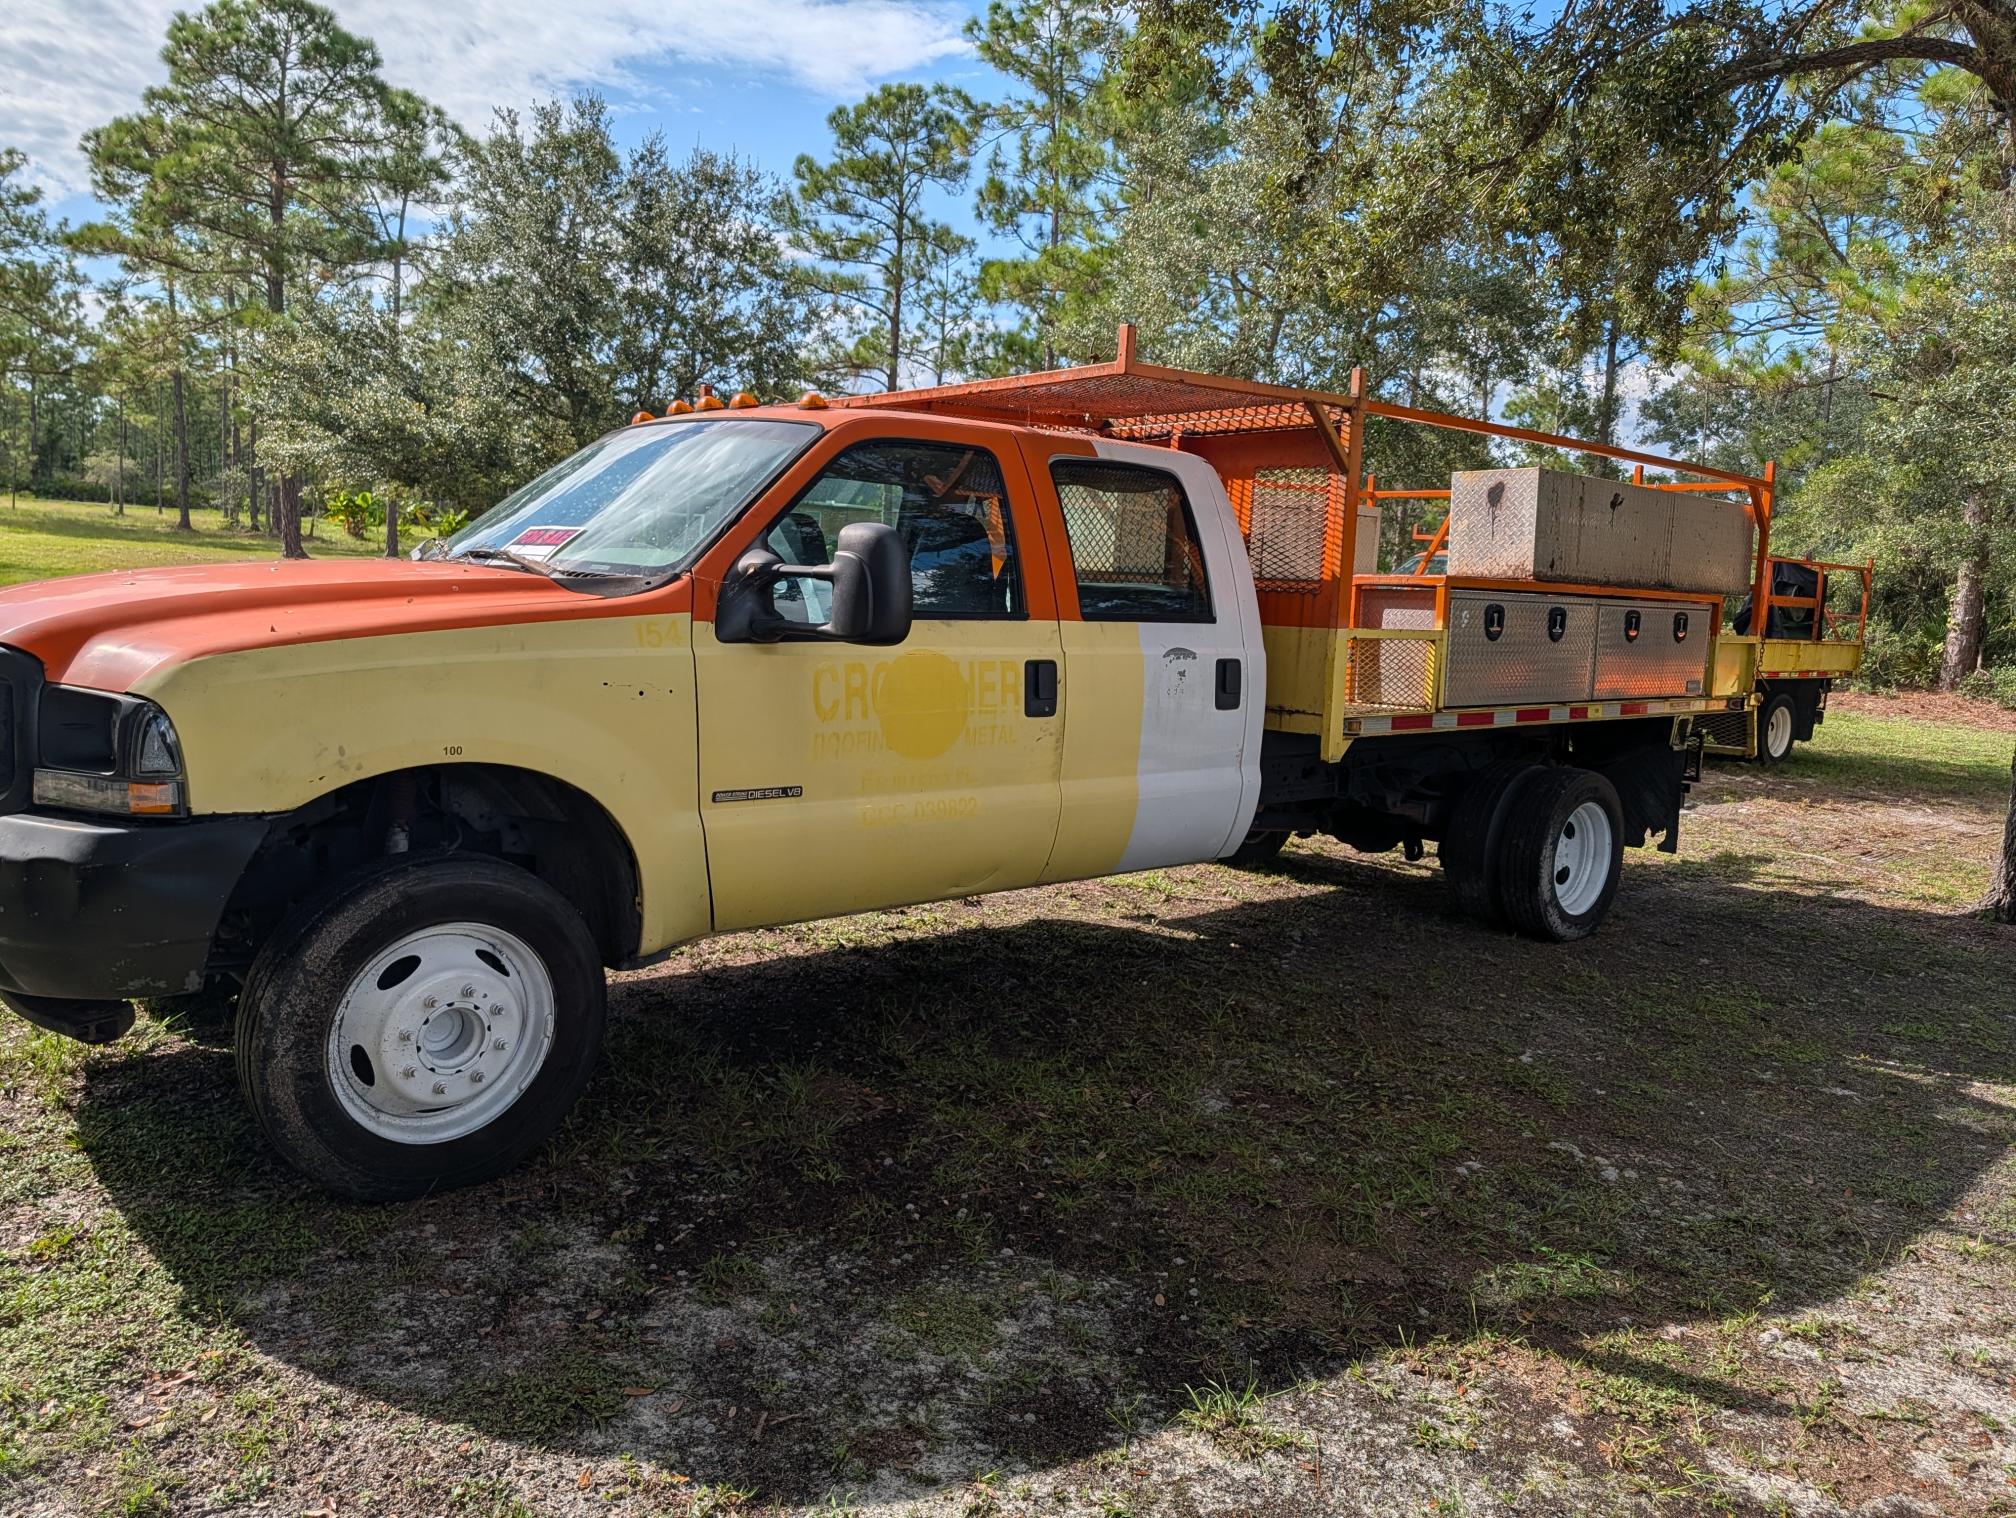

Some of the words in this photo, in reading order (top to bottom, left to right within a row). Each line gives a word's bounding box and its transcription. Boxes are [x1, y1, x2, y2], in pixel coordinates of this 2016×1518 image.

[634, 618, 683, 649] 154
[442, 745, 463, 756] 100
[748, 788, 786, 799] DIESEL
[787, 787, 802, 796] V8
